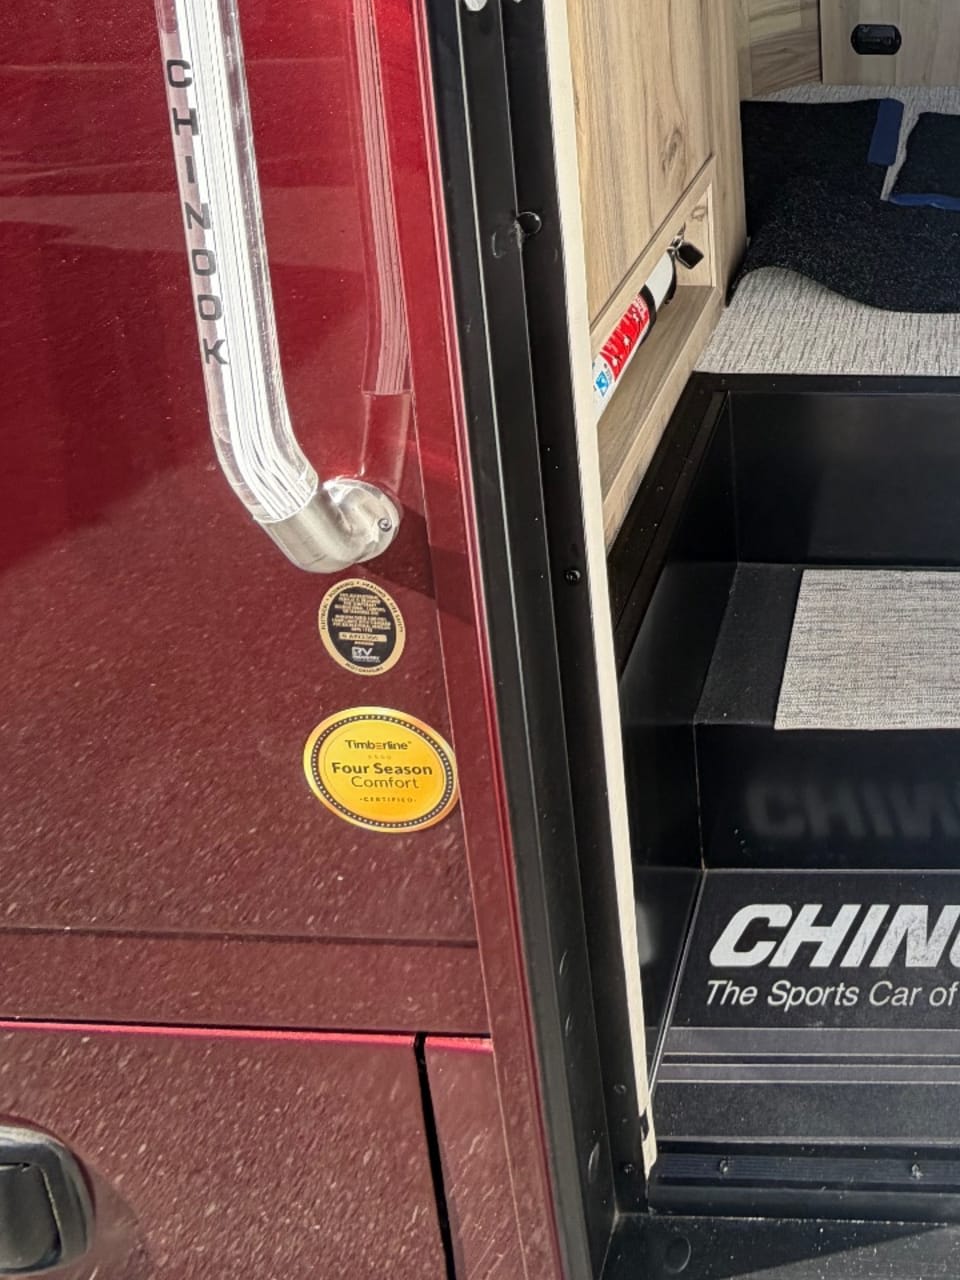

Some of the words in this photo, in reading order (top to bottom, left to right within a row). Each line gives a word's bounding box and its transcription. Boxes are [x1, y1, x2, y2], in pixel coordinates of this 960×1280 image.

[166, 59, 229, 365] CHINOOK
[344, 739, 409, 750] Timberline
[331, 762, 370, 774] Four
[373, 762, 433, 775] Season
[351, 776, 420, 789] Comfort
[706, 980, 758, 1007] The
[766, 979, 859, 1013] Sports
[868, 980, 923, 1007] Car
[928, 980, 960, 1008] of
